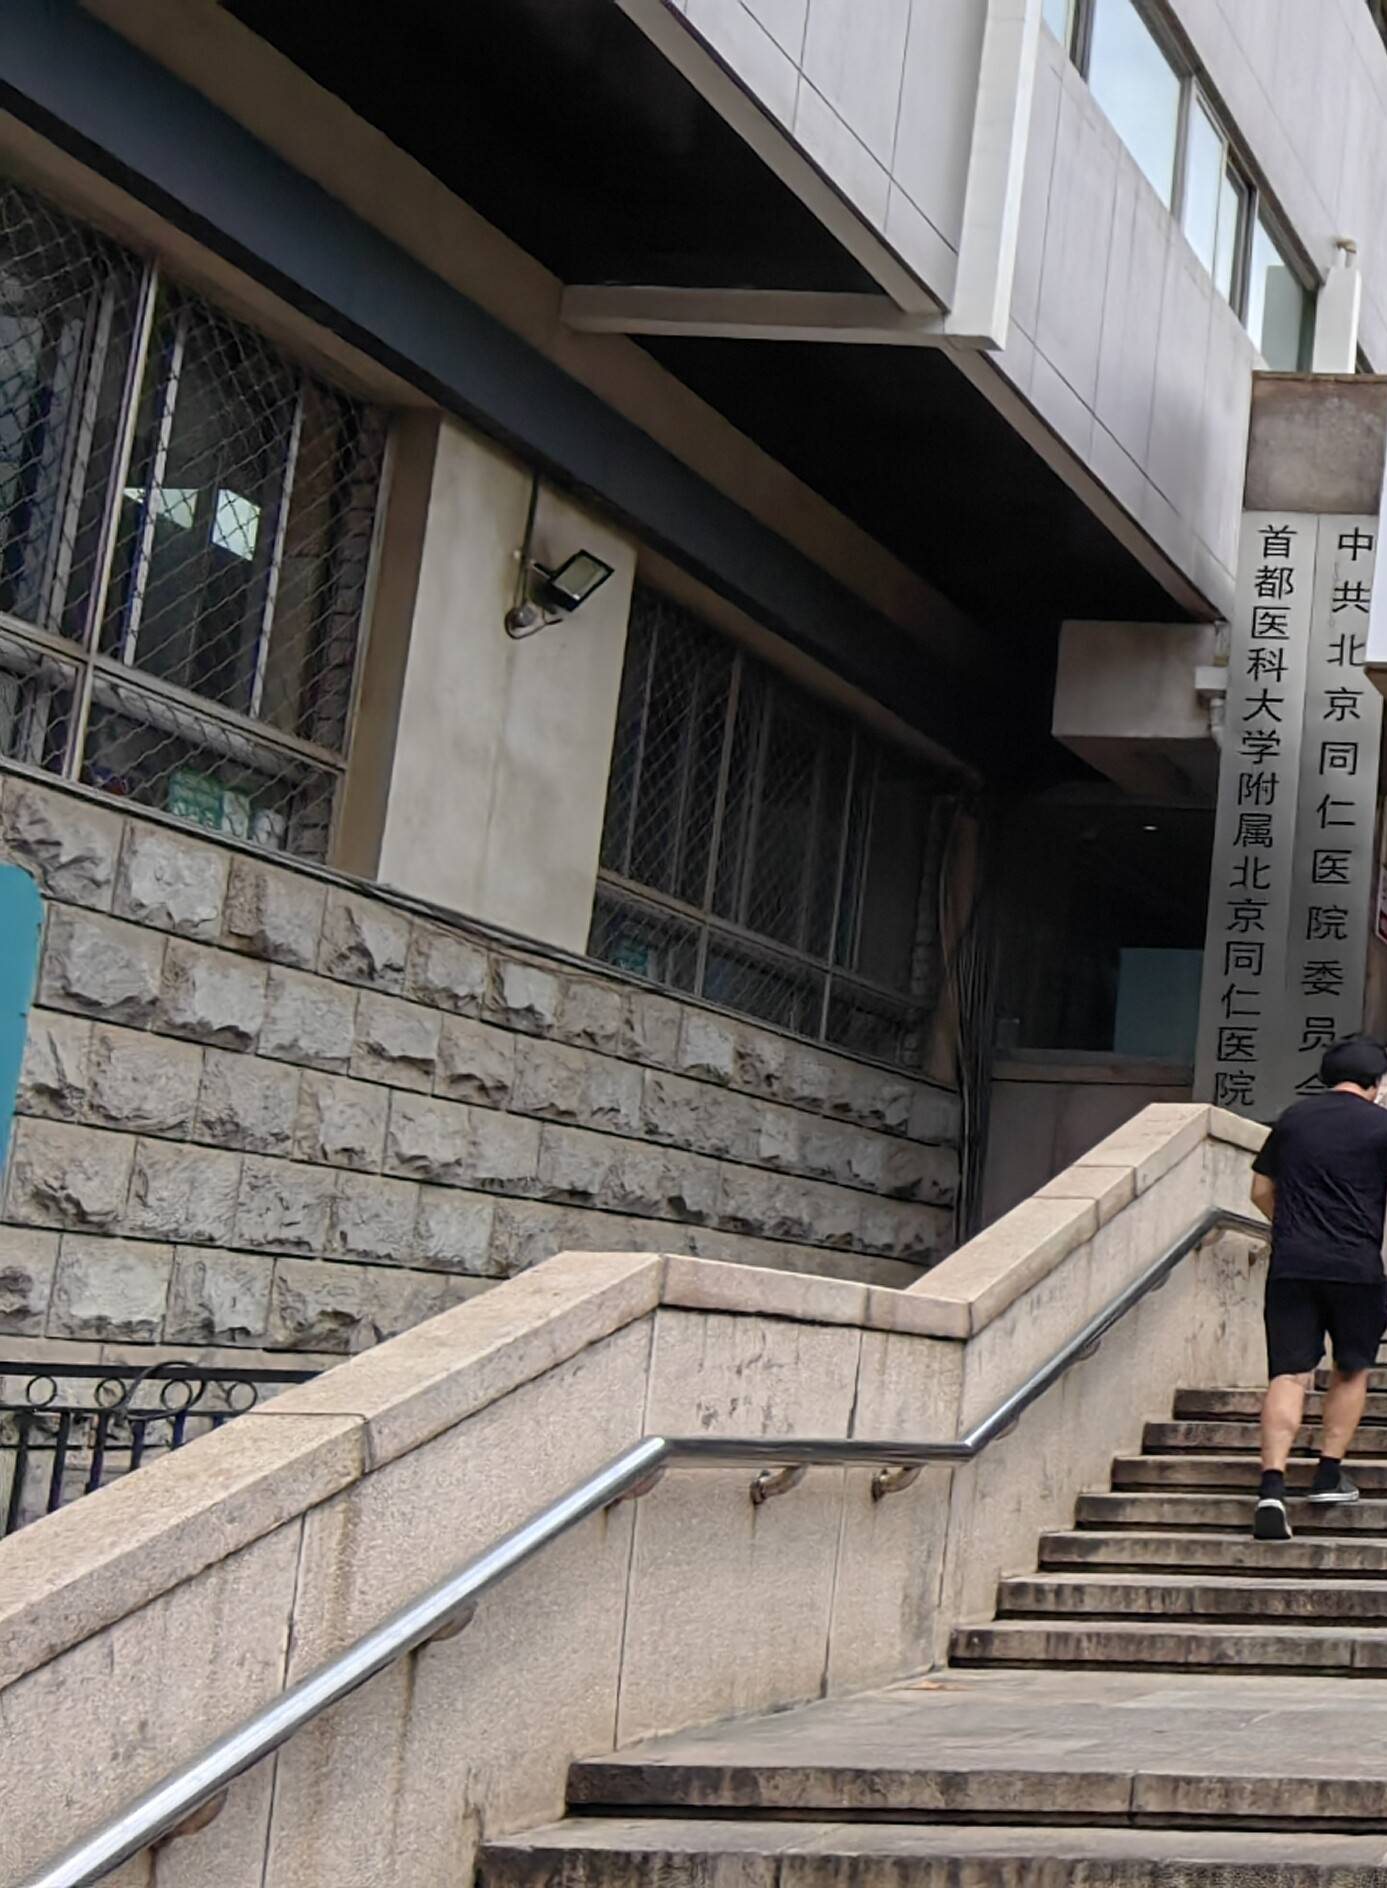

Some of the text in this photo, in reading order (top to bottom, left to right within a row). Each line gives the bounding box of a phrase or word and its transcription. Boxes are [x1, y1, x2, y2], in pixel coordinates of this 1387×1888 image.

[1215, 524, 1297, 1106] 首都医科大学附属北京同仁医院
